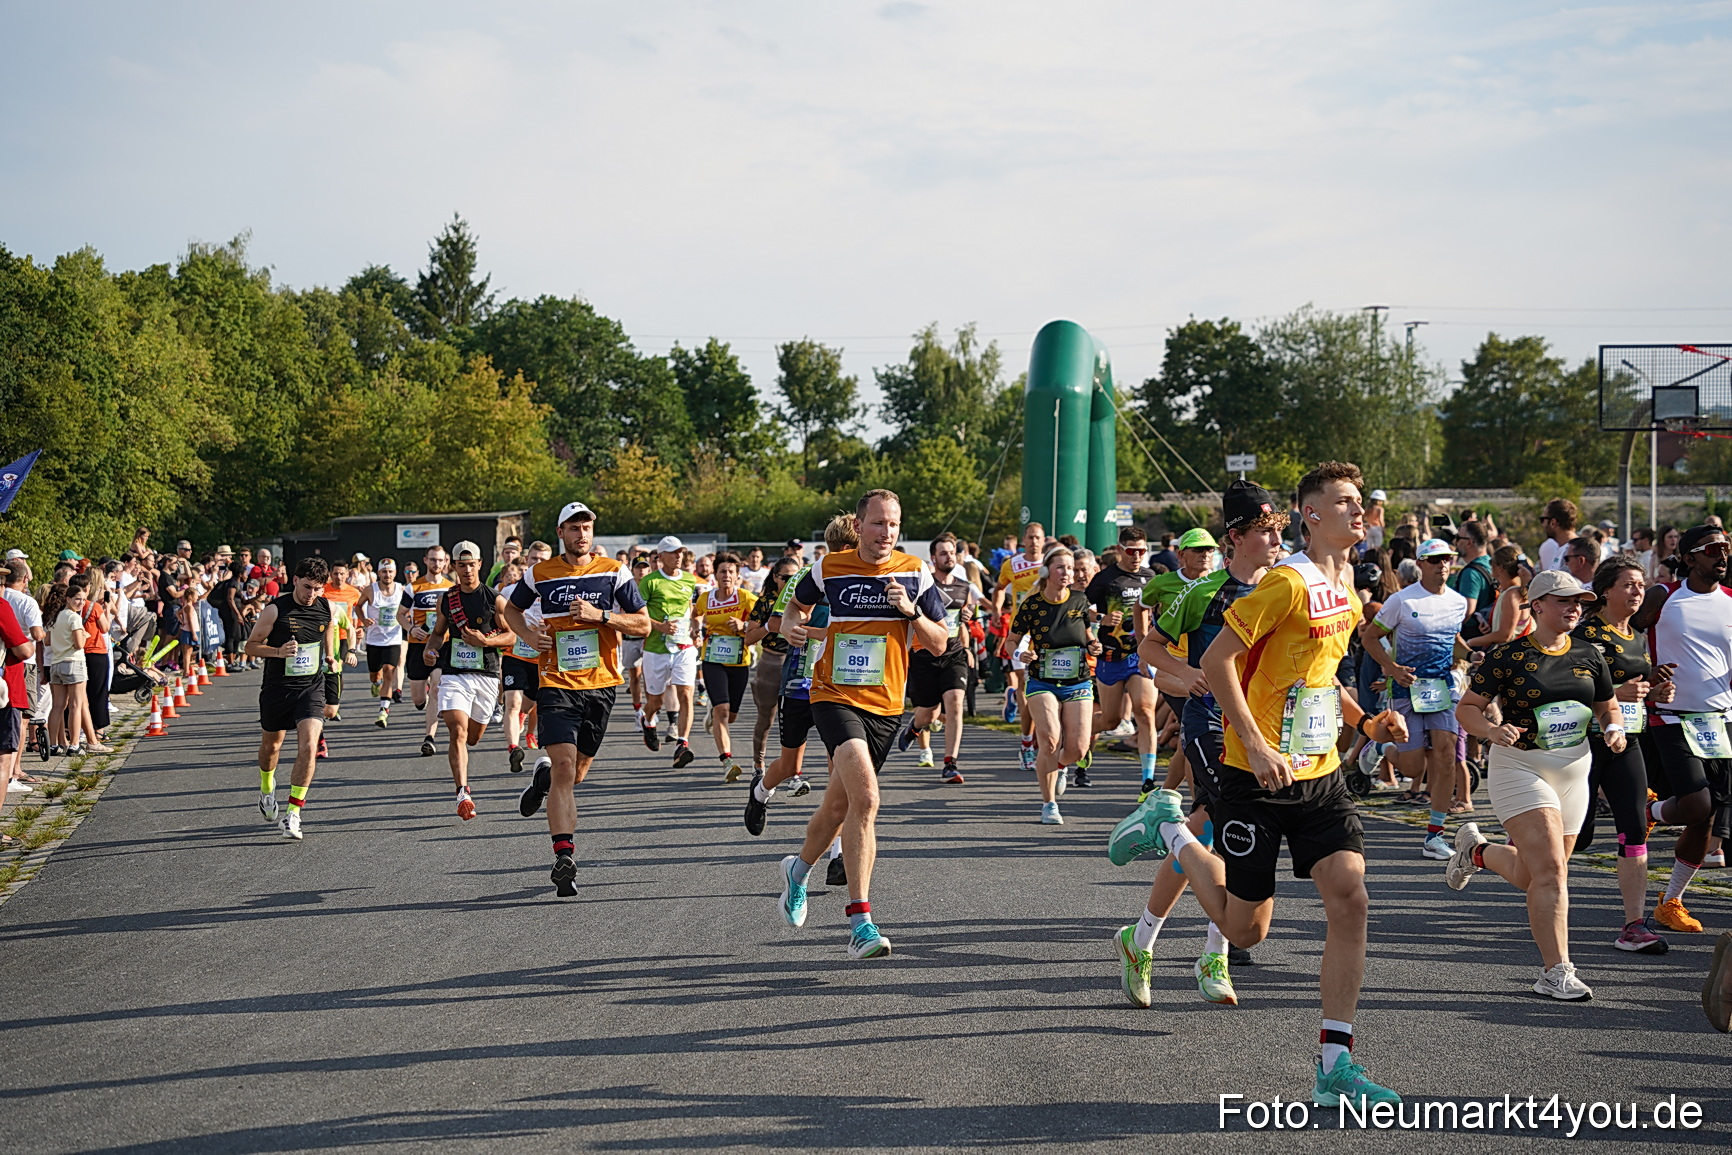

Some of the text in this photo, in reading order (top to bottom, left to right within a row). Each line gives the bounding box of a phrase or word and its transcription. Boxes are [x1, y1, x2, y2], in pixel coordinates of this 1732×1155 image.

[558, 591, 602, 602] Fischer
[849, 593, 889, 603] Fisch
[1309, 622, 1336, 639] MAX
[456, 651, 476, 659] 4028
[567, 646, 588, 656] 885
[717, 646, 731, 654] 1710
[296, 656, 310, 664] 221
[848, 655, 869, 667] 891
[1052, 659, 1072, 667] 2136
[1309, 715, 1326, 729] 1741
[1548, 721, 1578, 733] 2109
[1226, 832, 1252, 843] VOLVO
